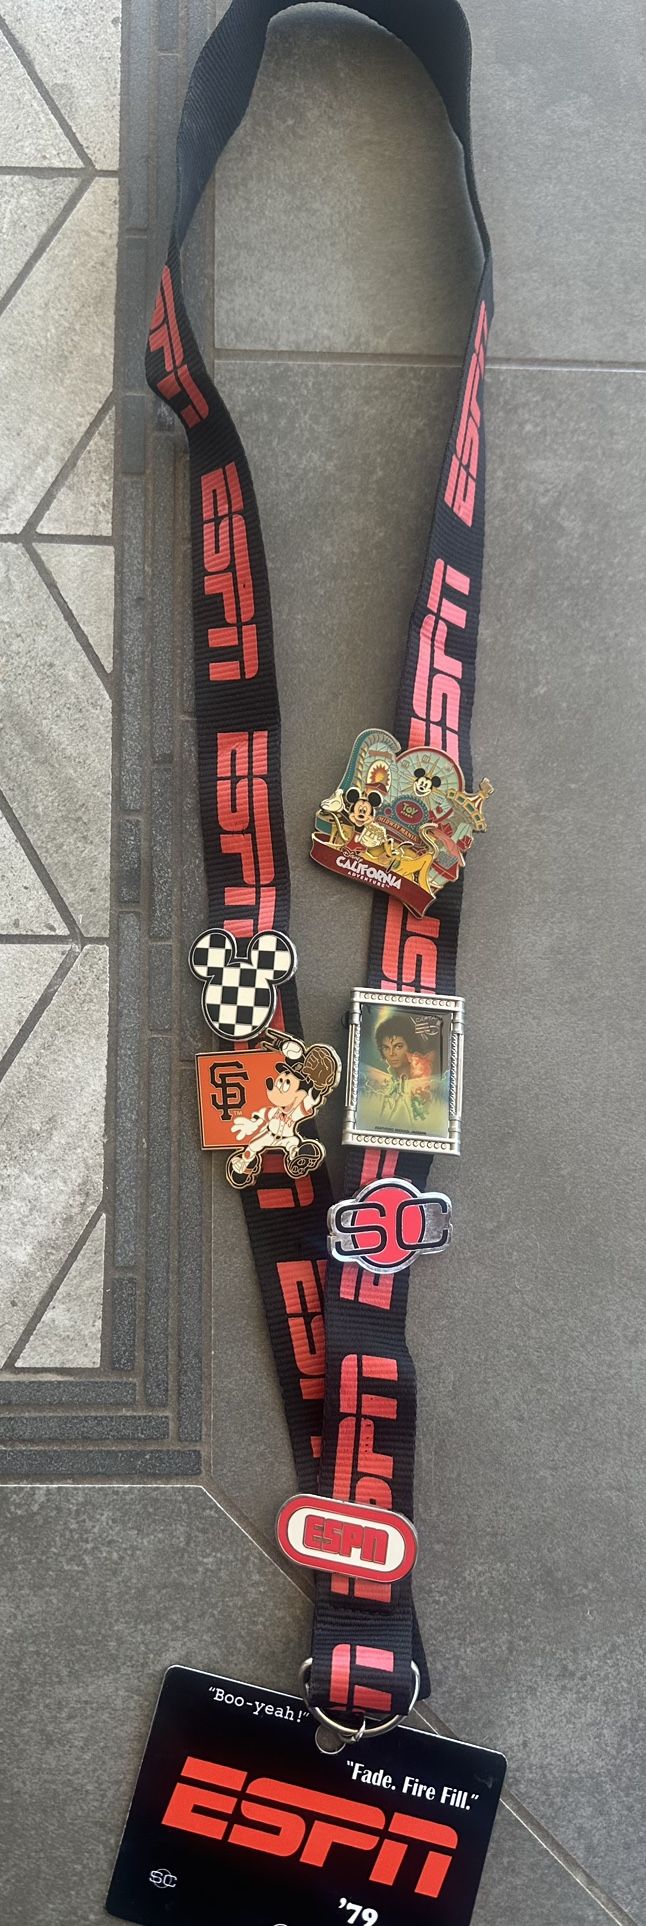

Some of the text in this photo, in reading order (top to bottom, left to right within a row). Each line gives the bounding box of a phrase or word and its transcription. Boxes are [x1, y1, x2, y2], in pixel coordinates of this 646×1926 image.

[201, 462, 259, 681] ESPN
[216, 730, 276, 938] ESPN
[336, 855, 402, 890] CALIFORNIA
[334, 1197, 448, 1257] SC
[302, 1514, 389, 1565] ESPN
[402, 1776, 436, 1801] Fire
[161, 1755, 458, 1898] ESPN
[149, 1869, 178, 1888] SC
[338, 1897, 379, 1926] '79
